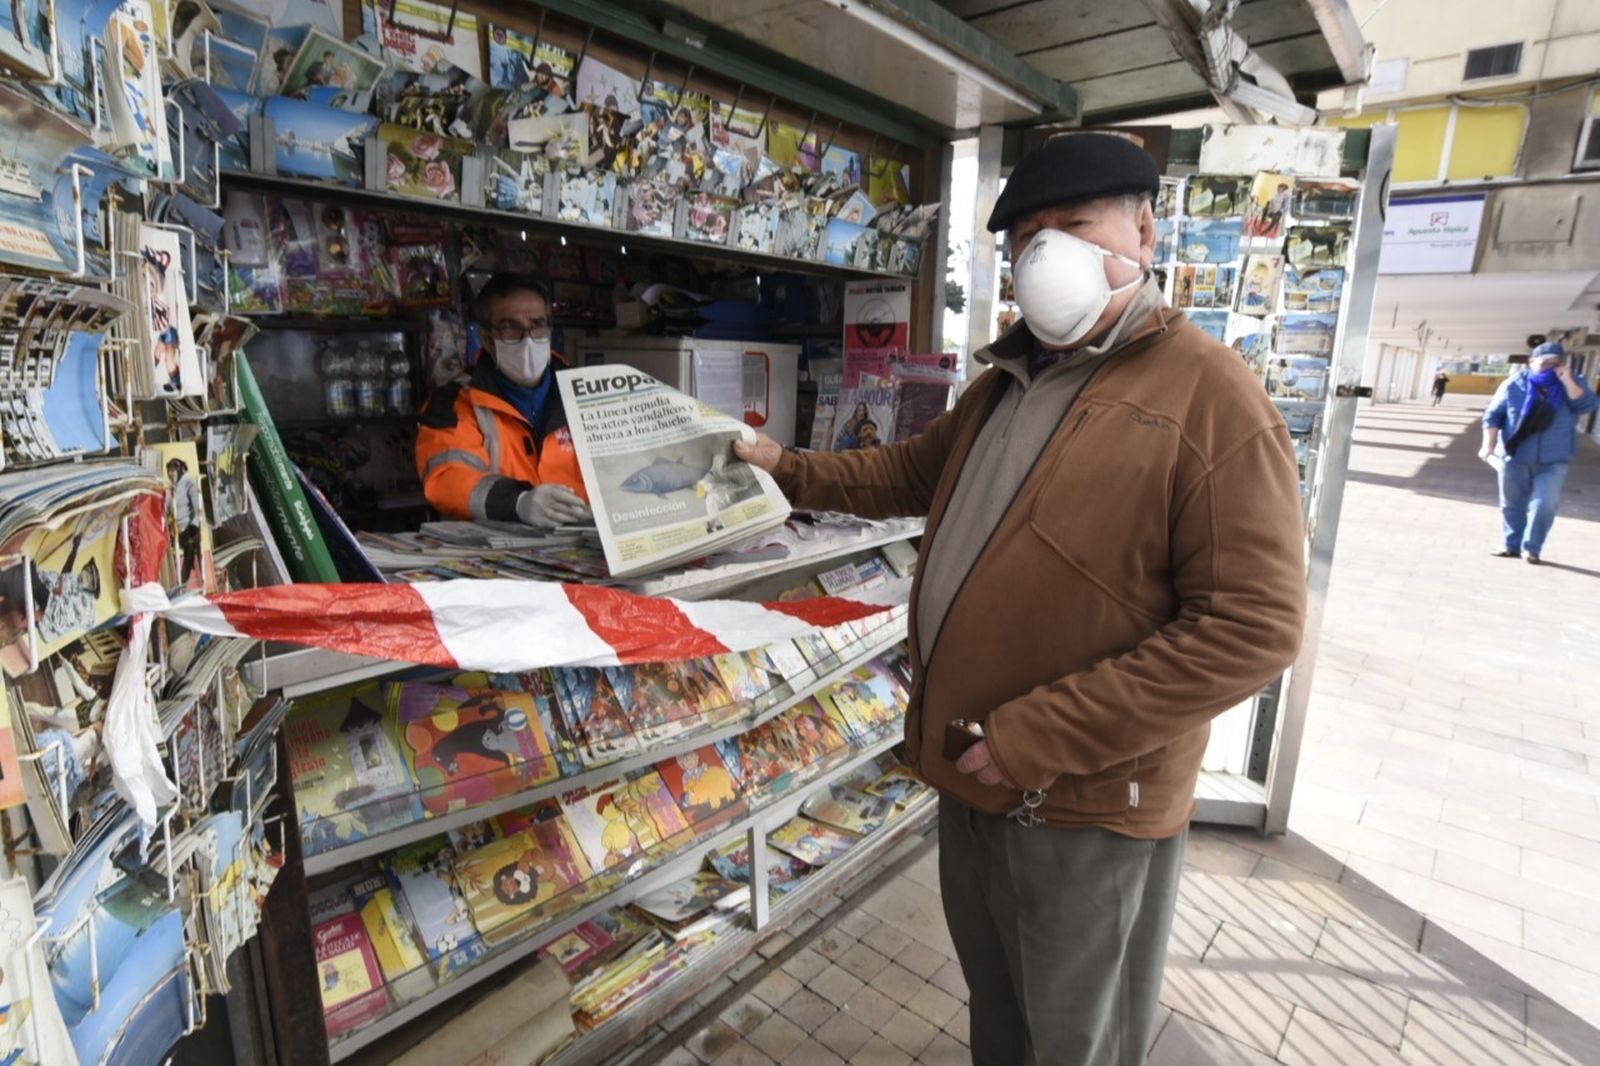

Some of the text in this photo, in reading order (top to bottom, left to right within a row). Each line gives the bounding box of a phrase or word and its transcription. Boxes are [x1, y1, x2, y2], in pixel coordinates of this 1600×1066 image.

[571, 374, 656, 397] Europa
[580, 411, 595, 422] La
[628, 397, 671, 415] repudia
[582, 422, 600, 433] los
[601, 418, 630, 430] actos
[585, 431, 625, 444] abraza
[626, 430, 633, 438] a
[634, 426, 652, 437] los
[652, 414, 693, 433] abuelos
[611, 500, 687, 523] Desinfección
